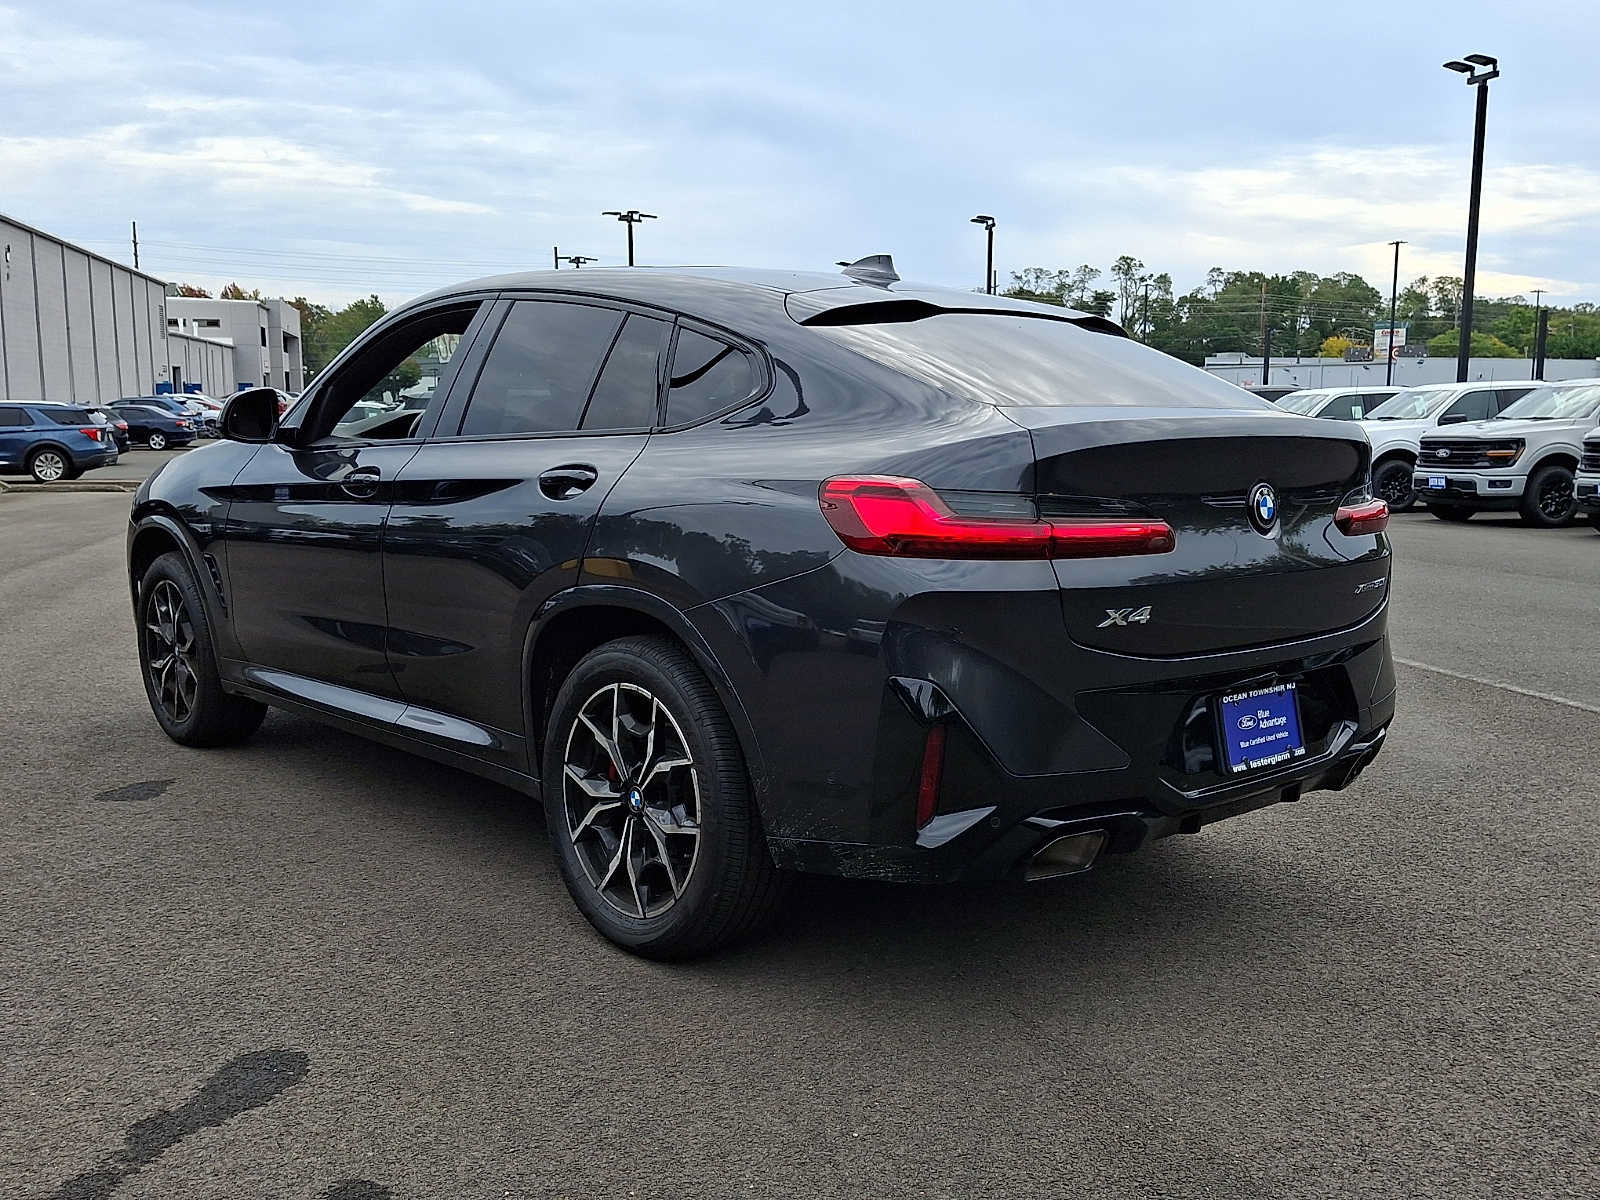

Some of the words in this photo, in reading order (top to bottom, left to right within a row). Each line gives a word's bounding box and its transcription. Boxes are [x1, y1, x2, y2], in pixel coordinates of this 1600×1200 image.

[1096, 605, 1152, 628] X4
[1222, 692, 1247, 703] OCEAN
[1257, 709, 1270, 719] Blue
[1240, 716, 1255, 728] Ford
[1259, 716, 1286, 728] Advantage
